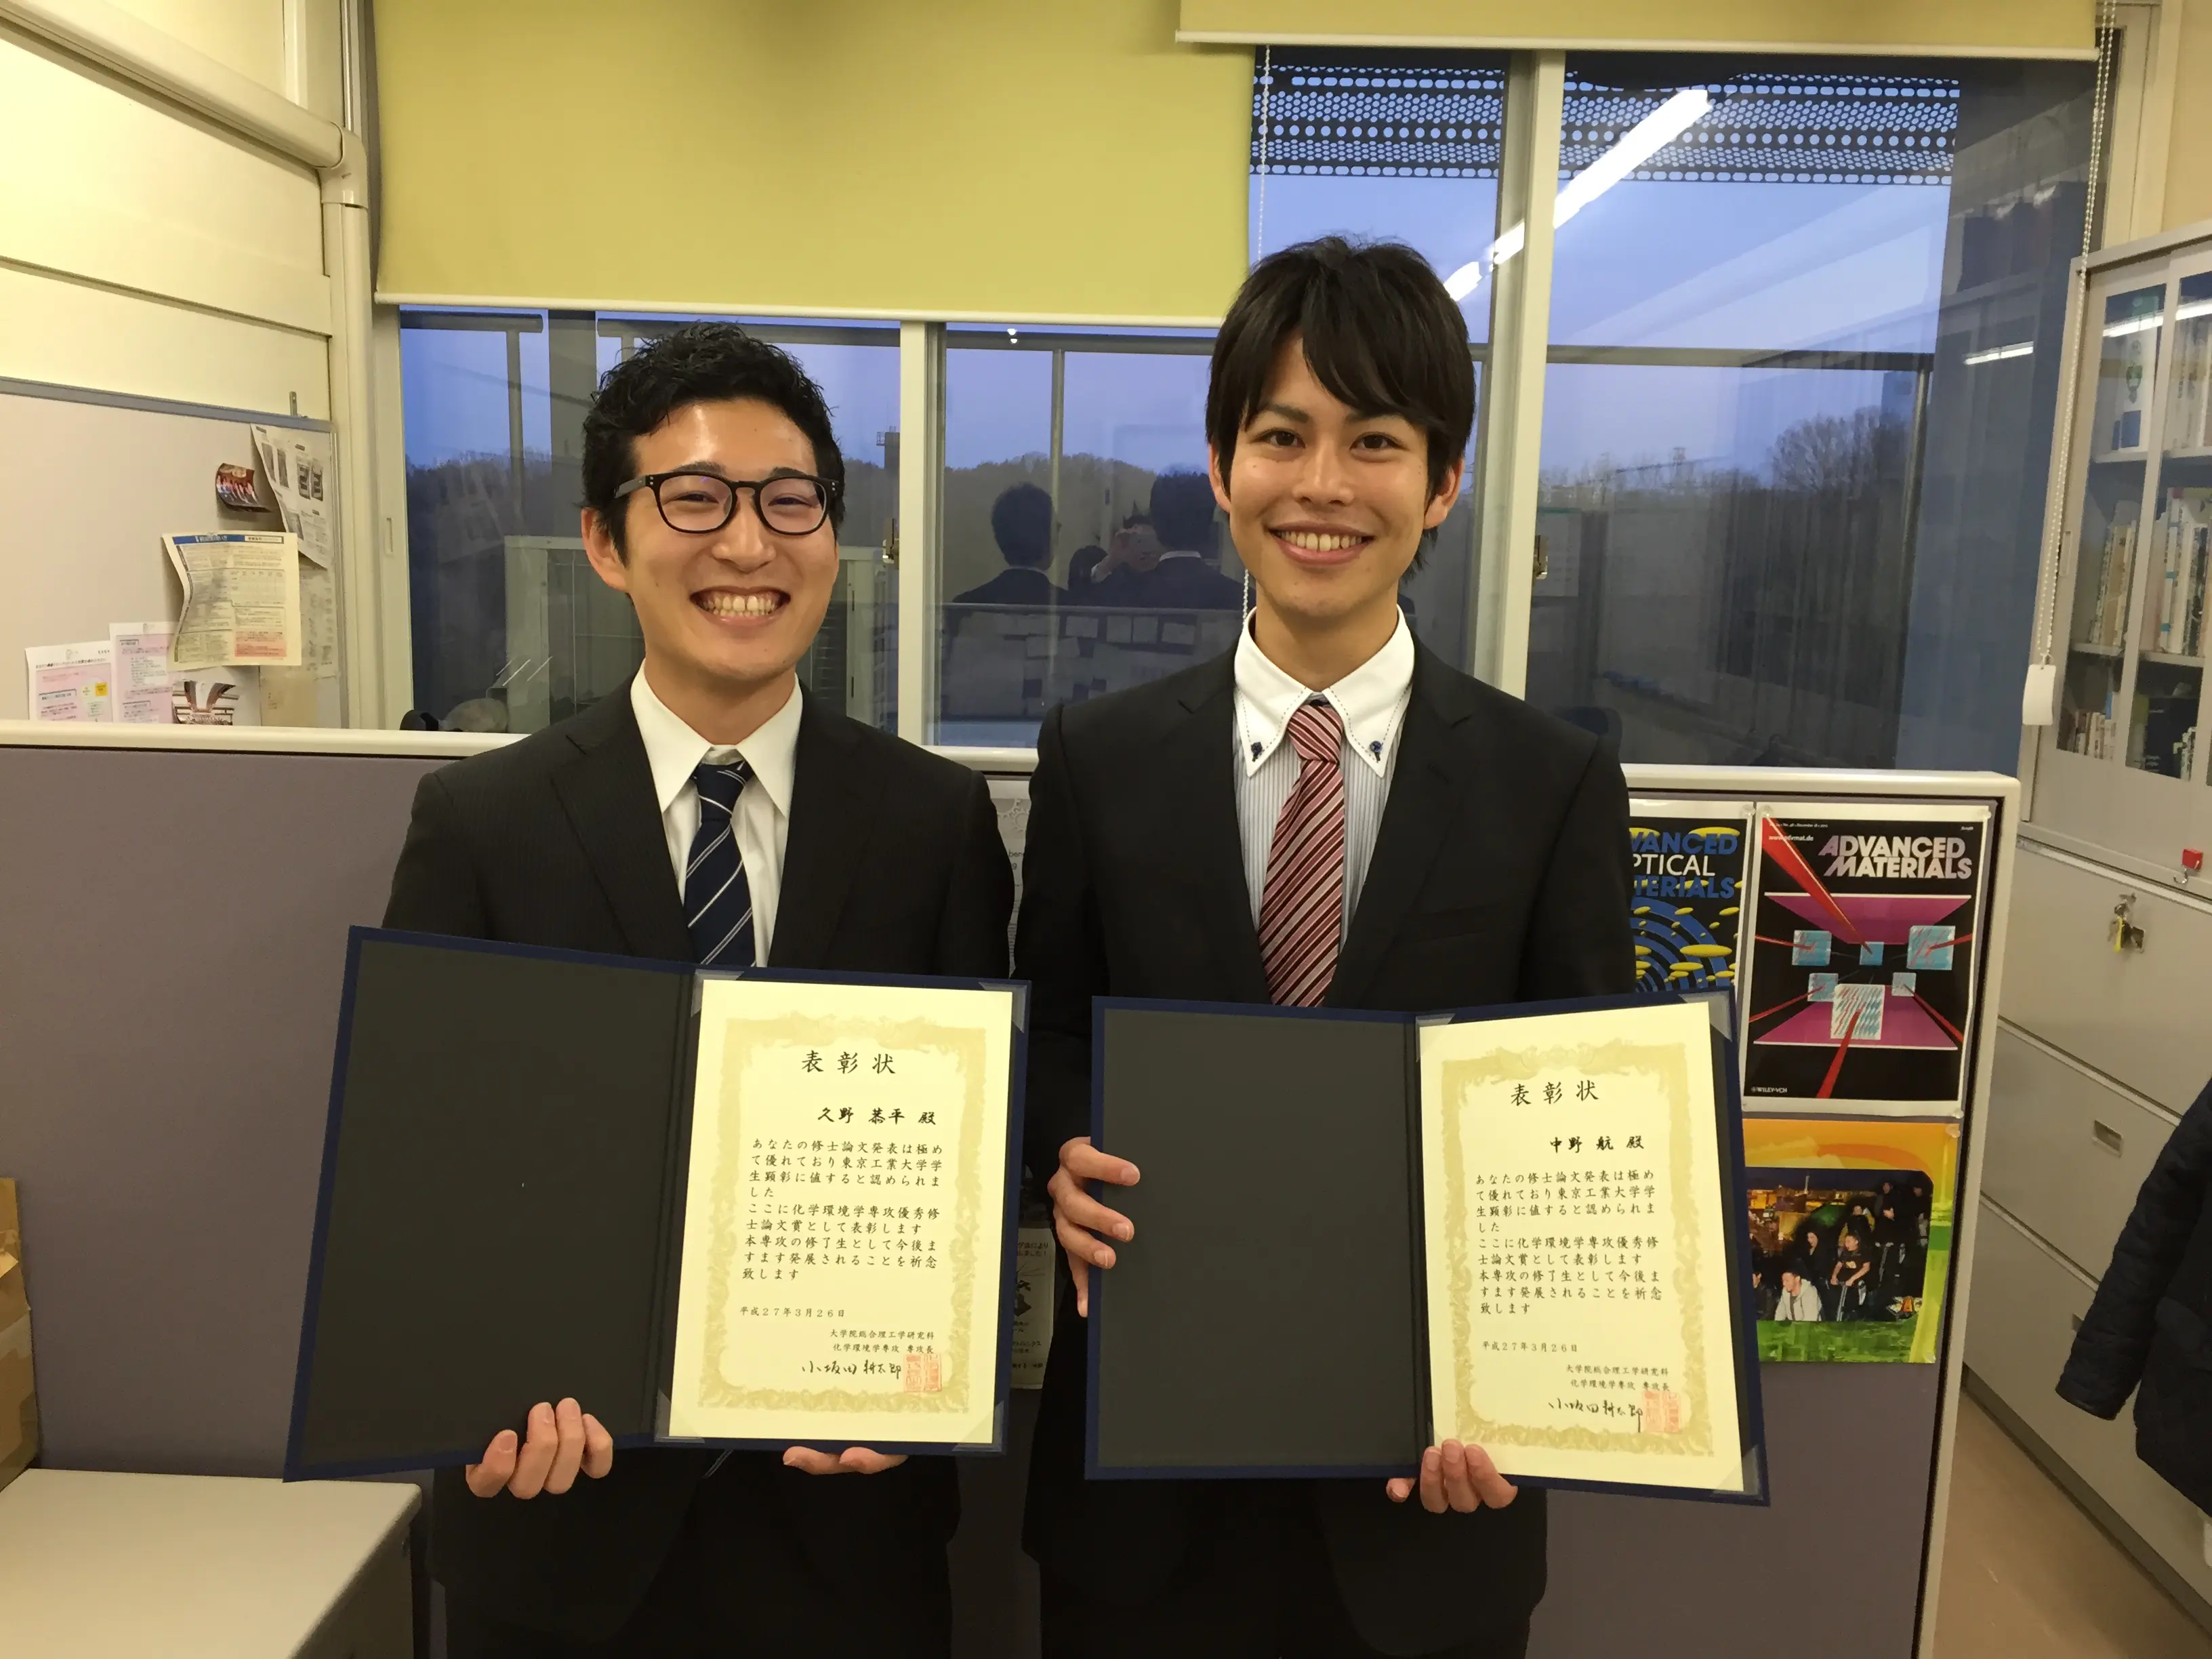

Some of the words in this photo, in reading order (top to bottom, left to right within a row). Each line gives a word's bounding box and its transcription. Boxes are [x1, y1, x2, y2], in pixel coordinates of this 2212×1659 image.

[1629, 832, 1738, 855] VANCED
[1818, 835, 1966, 859] ADVANCED
[1633, 853, 1716, 876] PTICAL
[1824, 856, 1972, 879] MATERIALS
[1633, 874, 1735, 899] TERIALS
[801, 1049, 896, 1075] 表彰状
[1510, 1079, 1599, 1107] 表彰状
[817, 1106, 855, 1124] 久野
[867, 1107, 905, 1126] 恭平
[918, 1111, 937, 1126] 殿
[752, 1138, 943, 1155] あなたの修士論文発表は極め
[1549, 1136, 1583, 1154] 中野
[1595, 1135, 1614, 1151] 航
[1625, 1134, 1645, 1149] 殿
[752, 1153, 943, 1172] て優れており東京工業大学学
[749, 1169, 939, 1187] 生顕彰に値すると認められま
[750, 1187, 774, 1198] した
[748, 1203, 940, 1221] ここに化学環境学専攻優秀修
[745, 1218, 922, 1235] 士論文賞として表彰します
[745, 1234, 936, 1252] 本専攻の修了生として今後ま
[744, 1251, 937, 1269] すます発展されることを祈念
[742, 1267, 799, 1281] 致します
